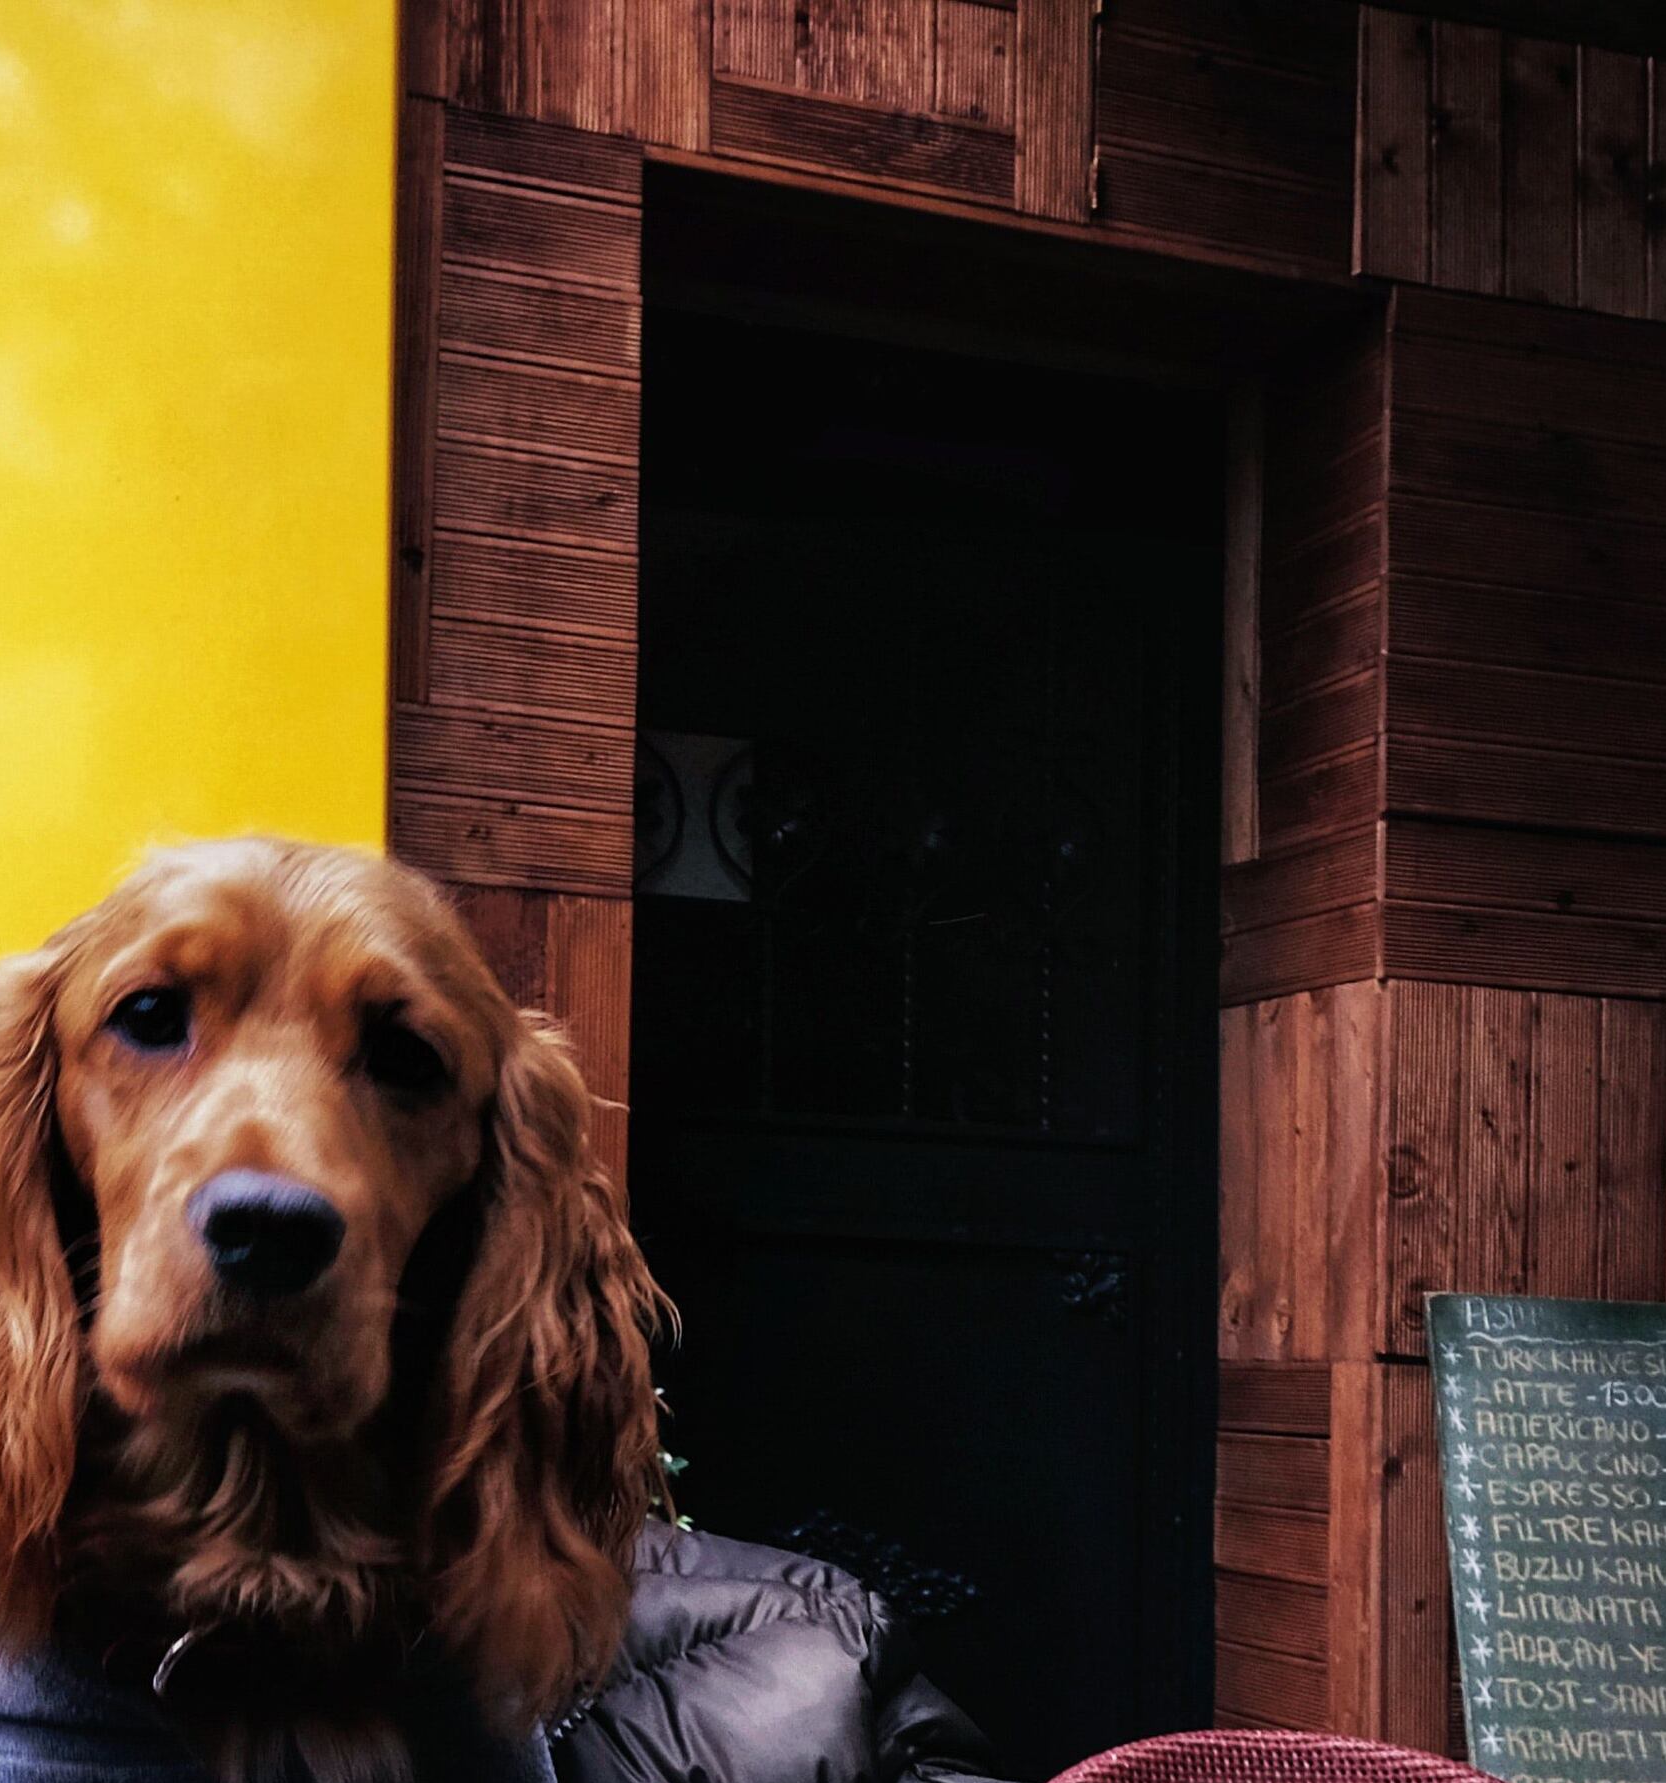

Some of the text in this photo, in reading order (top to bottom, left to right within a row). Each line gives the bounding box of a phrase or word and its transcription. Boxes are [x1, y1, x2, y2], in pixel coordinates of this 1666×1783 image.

[1472, 1377, 1577, 1407] LATTE
[1487, 1478, 1651, 1510] ESPRESSO
[1493, 1550, 1585, 1583] BUZLU
[1504, 1726, 1648, 1762] KAHVALTI
